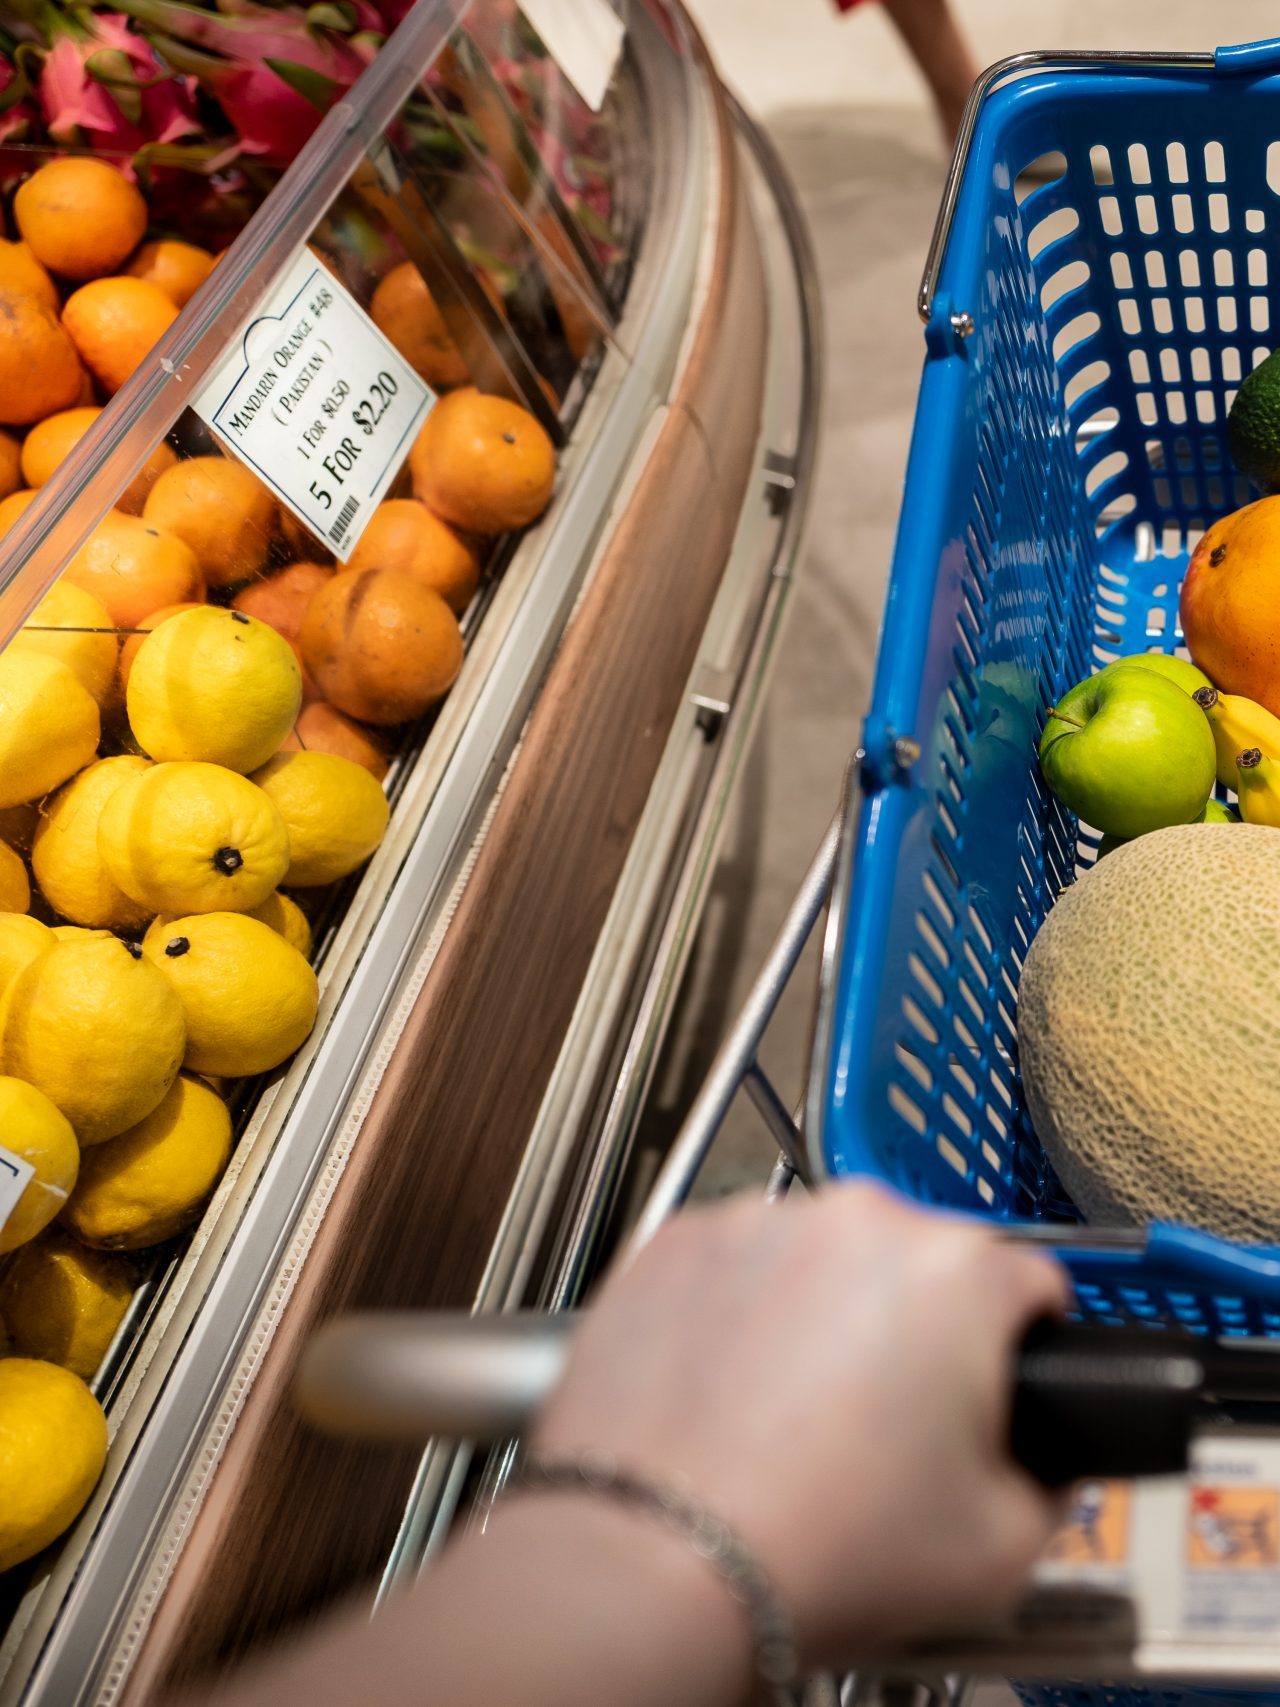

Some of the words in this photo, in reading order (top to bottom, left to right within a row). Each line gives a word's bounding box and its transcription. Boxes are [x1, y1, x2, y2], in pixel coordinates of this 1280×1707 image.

[297, 446, 310, 459] 1
[309, 480, 332, 510] 5
[352, 371, 398, 435] $2.20
